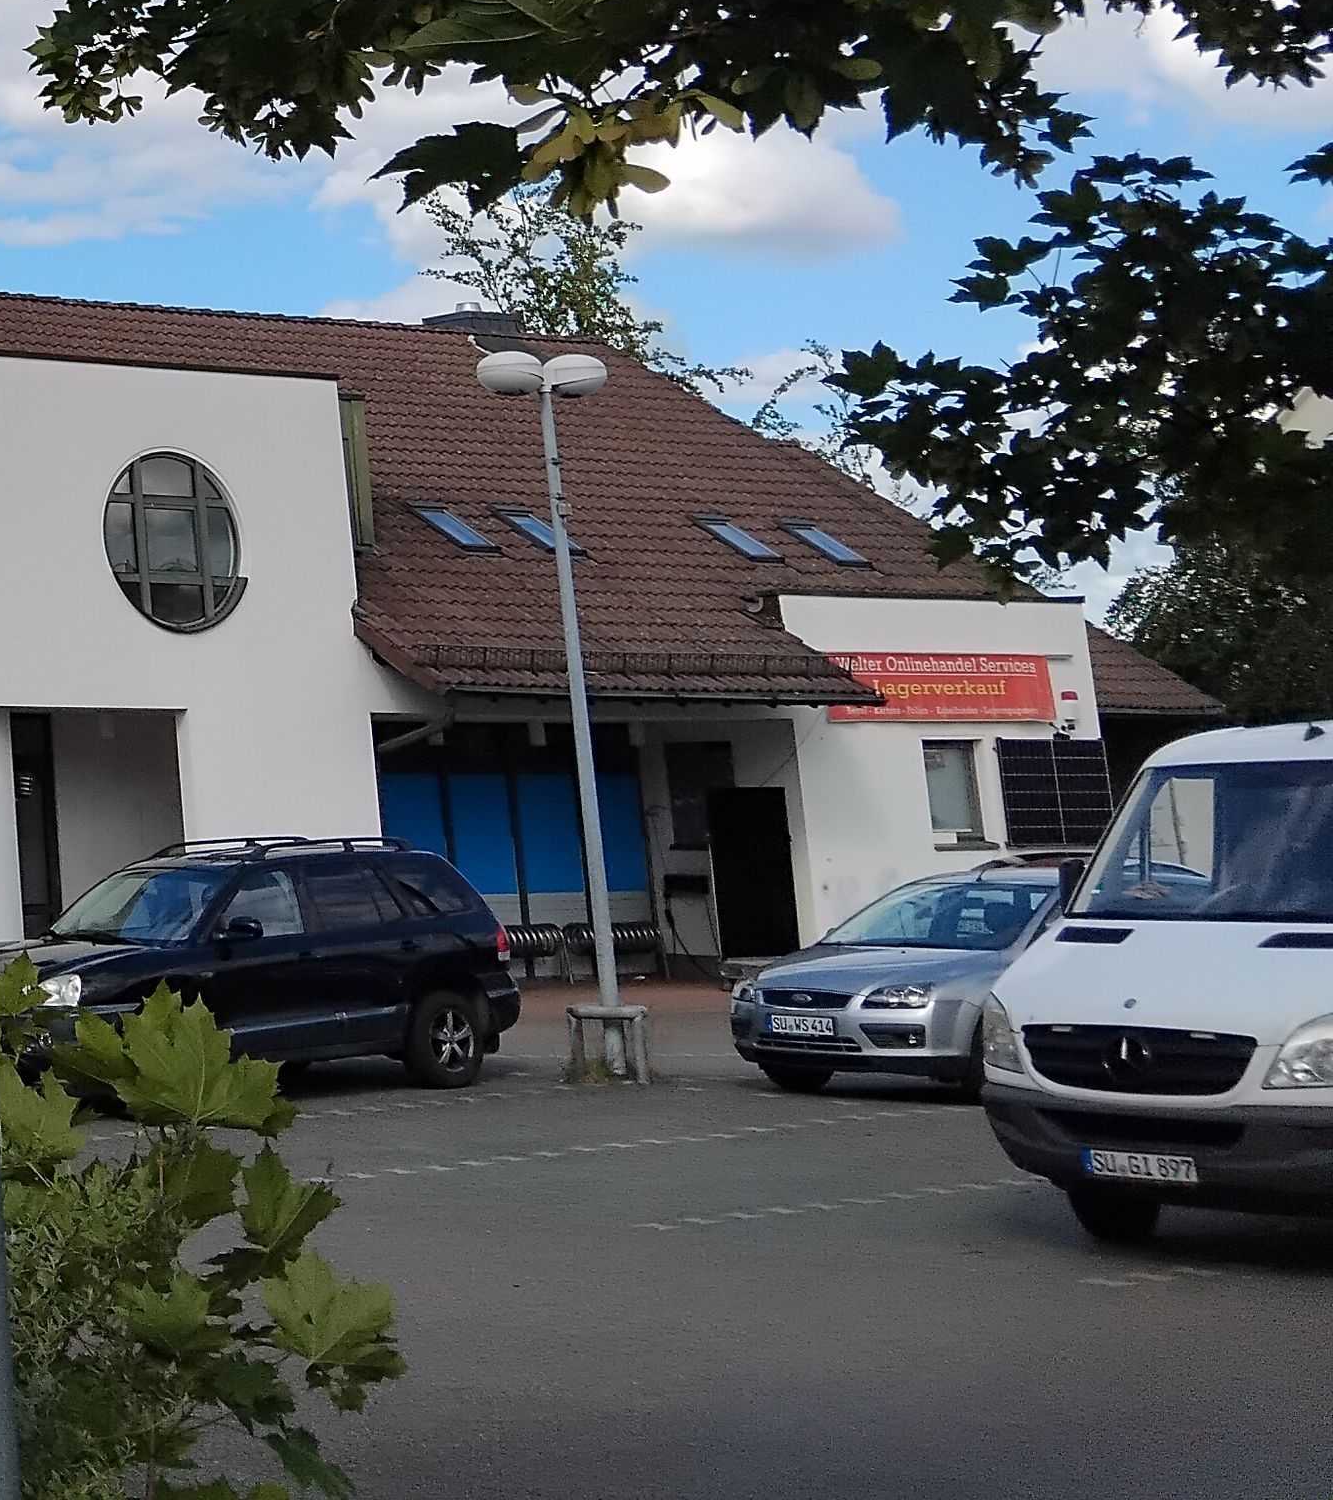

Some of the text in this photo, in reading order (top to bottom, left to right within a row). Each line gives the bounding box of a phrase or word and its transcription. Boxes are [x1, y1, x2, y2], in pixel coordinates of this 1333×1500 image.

[835, 655, 1037, 674] Welter Onlinehandel Services
[873, 679, 1006, 699] Lagerverkauf
